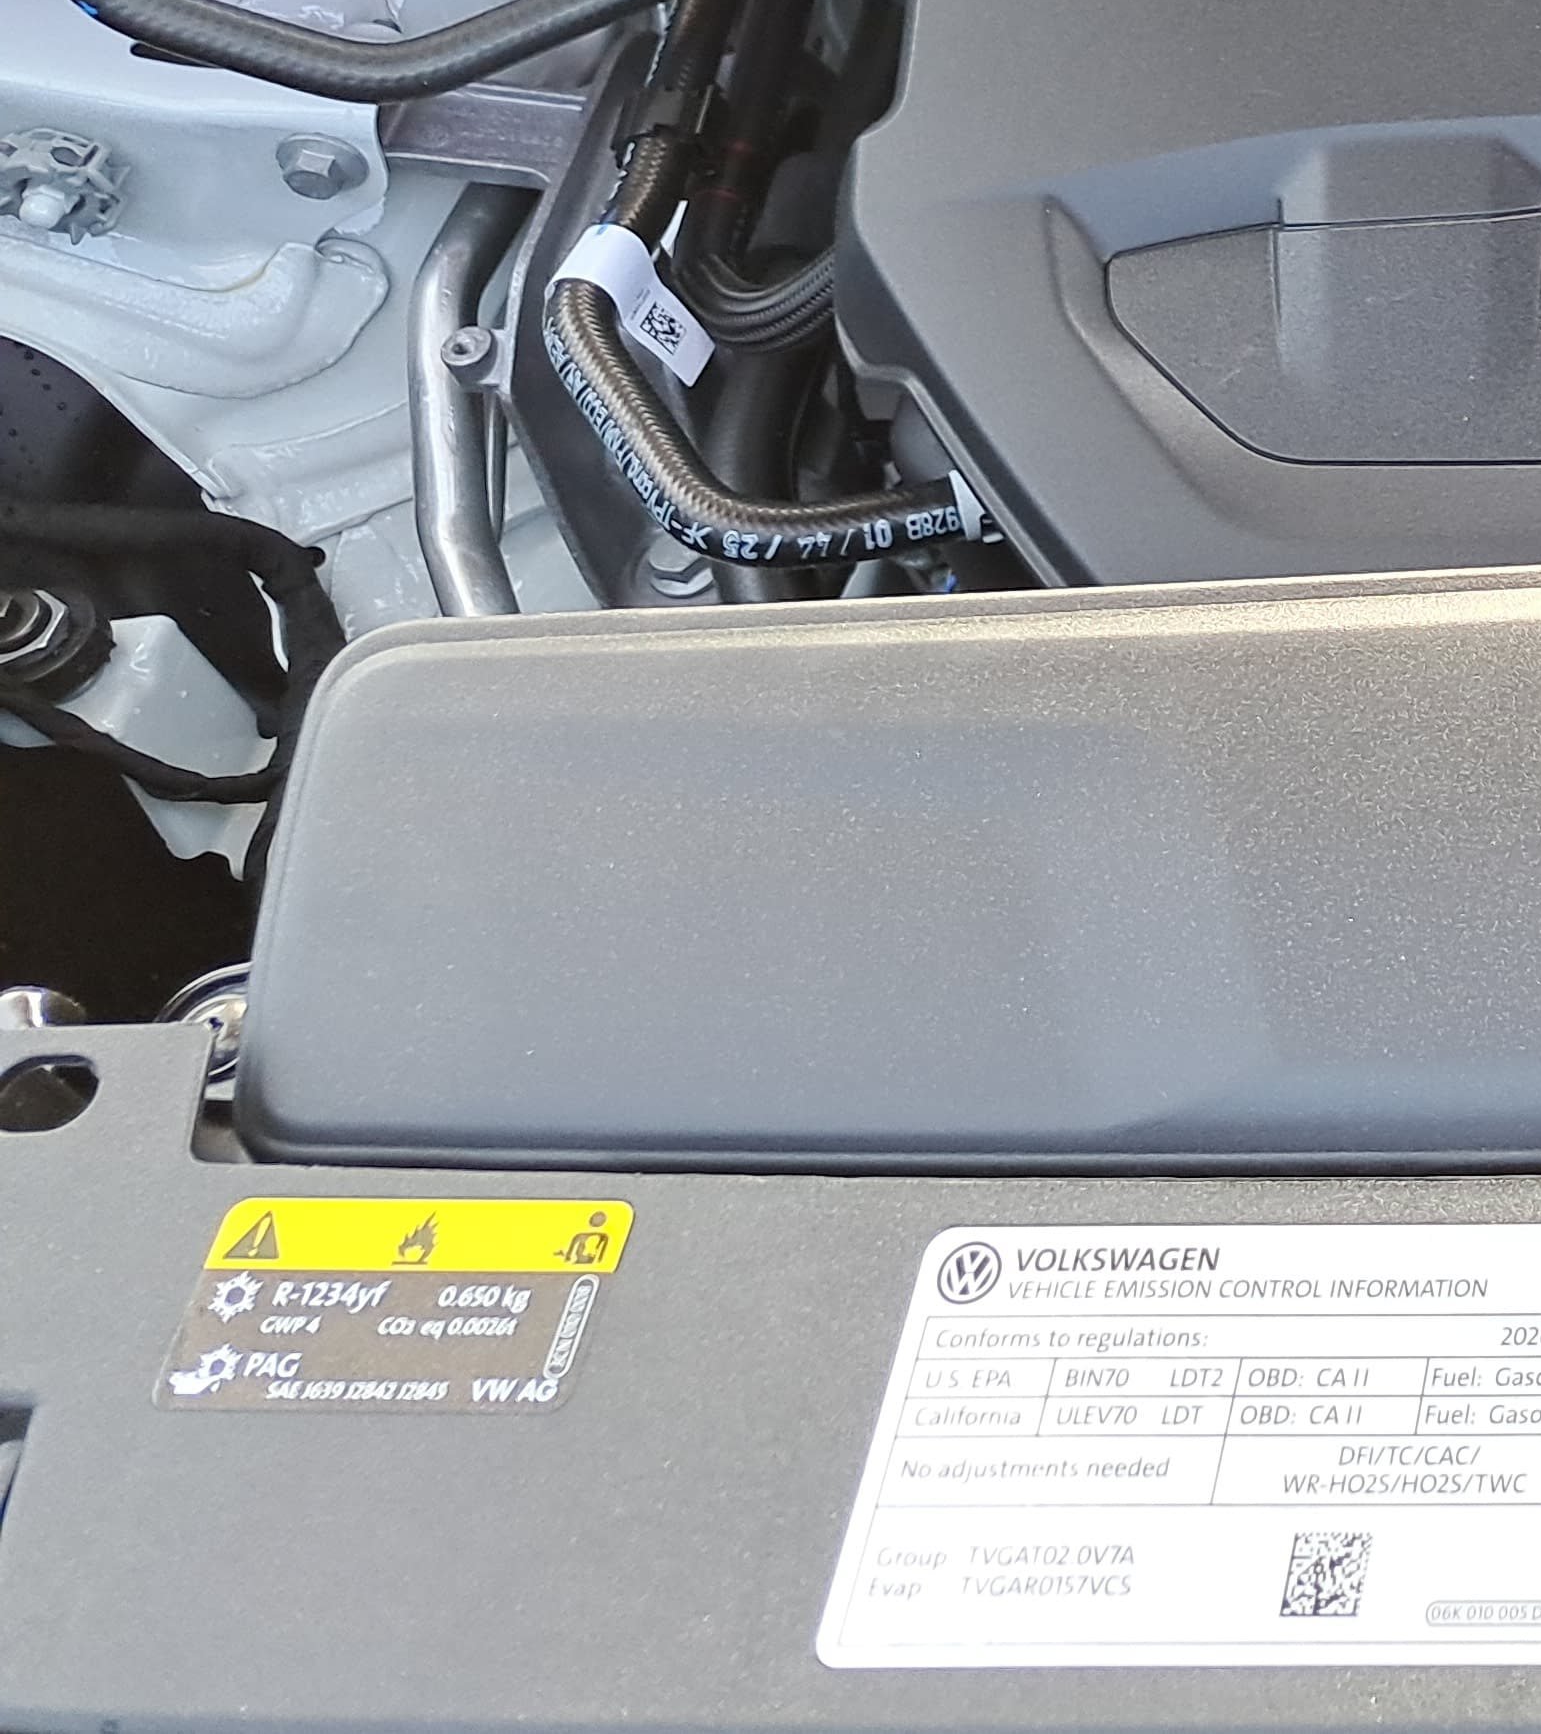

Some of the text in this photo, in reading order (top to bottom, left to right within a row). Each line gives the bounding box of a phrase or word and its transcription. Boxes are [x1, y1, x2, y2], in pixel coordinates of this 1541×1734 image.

[1016, 1247, 1220, 1273] VOLKSWAGEN
[272, 1280, 531, 1314] R-1234yf 0.650 kg
[1007, 1279, 1488, 1299] VEHICLE EMISSION CONTROL INFORMATION
[420, 1318, 445, 1341] eq
[936, 1328, 1208, 1353] Conforms to regulations:
[243, 1352, 302, 1378] PAG
[972, 1370, 1012, 1388] EPA
[1065, 1368, 1223, 1388] BIN70 LDT2
[1248, 1367, 1346, 1388] OBD: CA
[1431, 1367, 1482, 1387] Fuel:
[472, 1378, 559, 1403] VW AG
[914, 1405, 1022, 1427] California
[1056, 1405, 1204, 1426] ULEV70 LDT
[1240, 1405, 1339, 1426] OBD: CA
[1424, 1405, 1476, 1426] Fuel:
[1338, 1445, 1481, 1466] DFI/TC/CAC/
[900, 1458, 1170, 1483] No adjustments needed
[877, 1547, 948, 1570] Group
[869, 1576, 922, 1600] Evap
[1431, 1605, 1462, 1620] 06K
[1466, 1605, 1494, 1620] 010
[1498, 1605, 1528, 1620] 005
